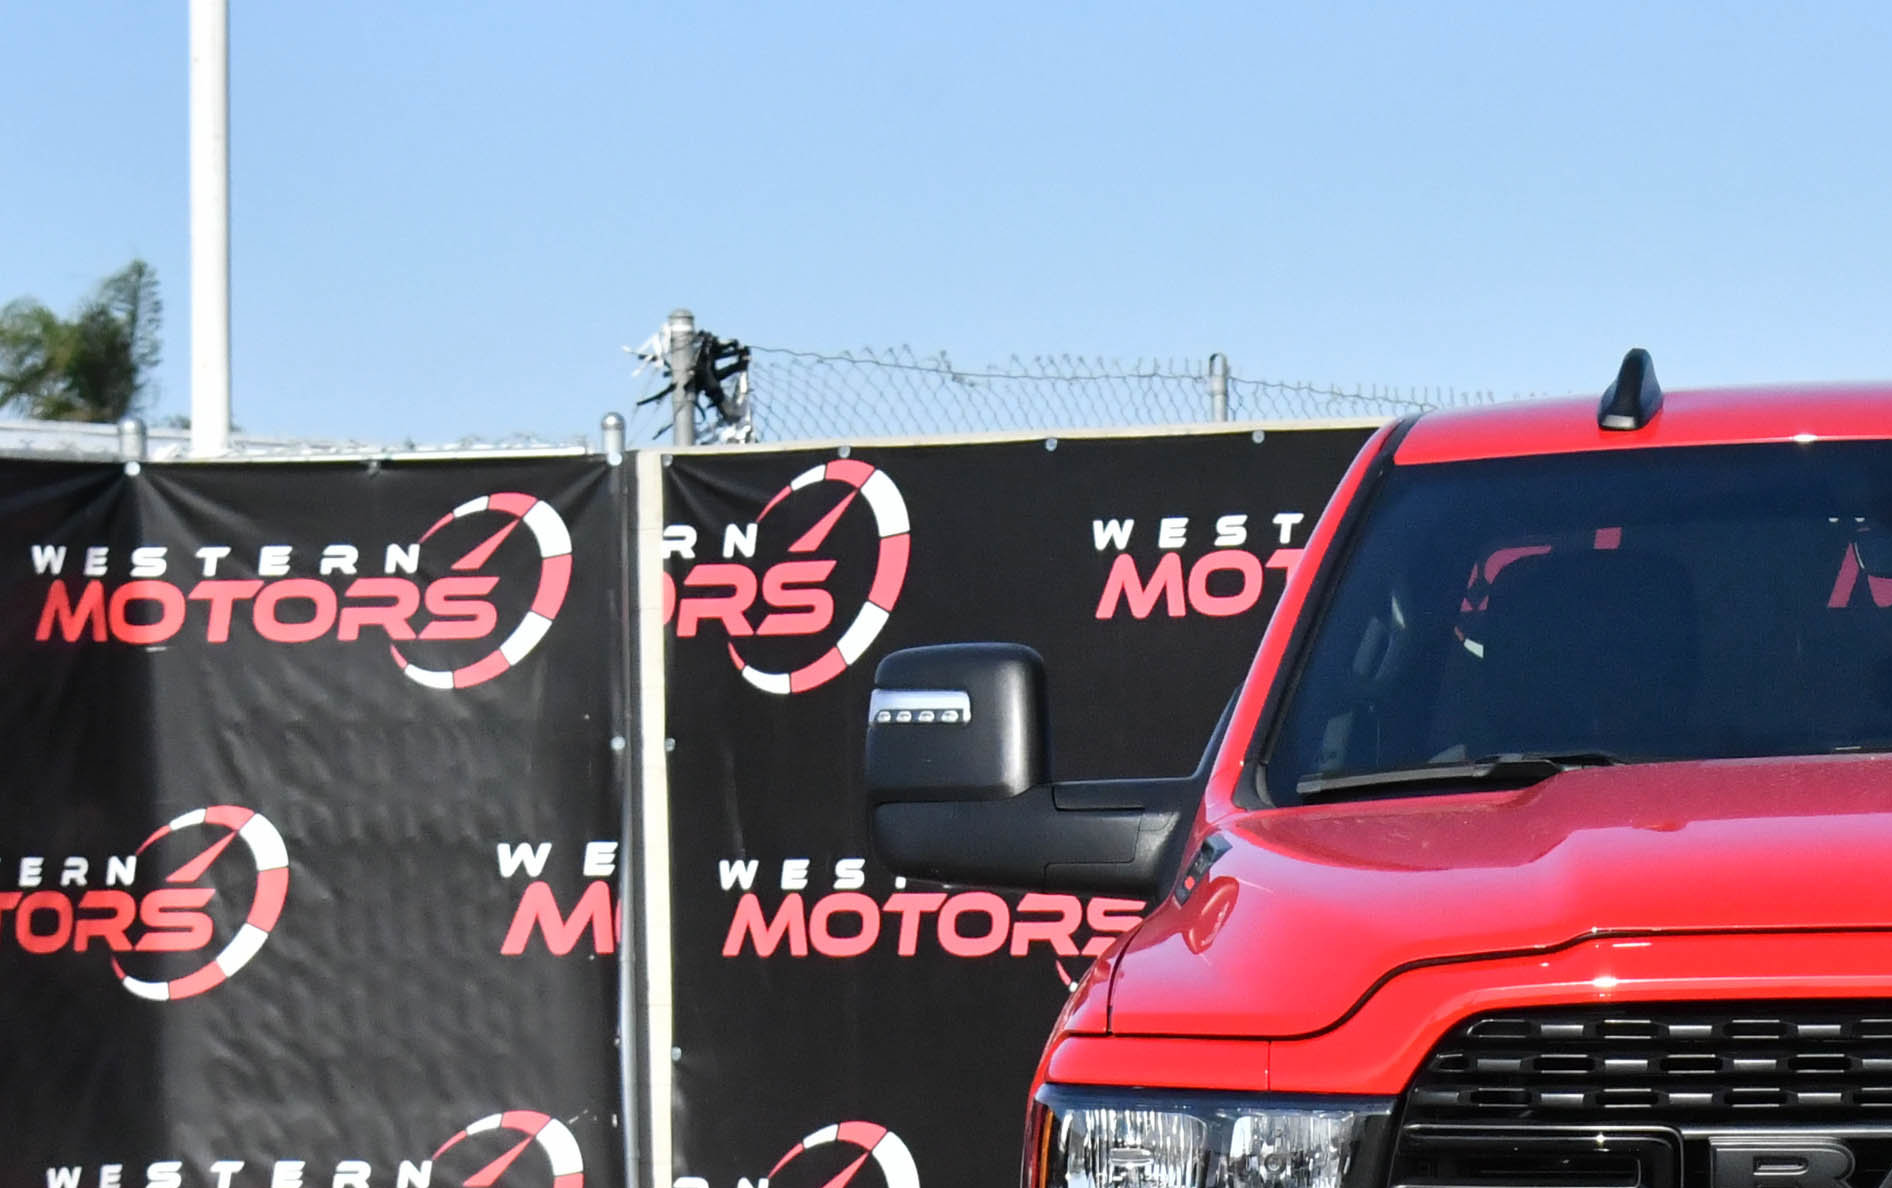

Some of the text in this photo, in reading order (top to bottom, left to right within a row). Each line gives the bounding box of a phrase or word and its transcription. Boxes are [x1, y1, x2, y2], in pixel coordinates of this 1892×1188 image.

[32, 543, 420, 577] WESTERN
[1093, 513, 1305, 551] WEST
[35, 576, 500, 645] MOTORS
[663, 560, 838, 638] RS
[719, 859, 907, 891] WES
[500, 880, 622, 957] M
[722, 891, 1147, 957] MOTORS
